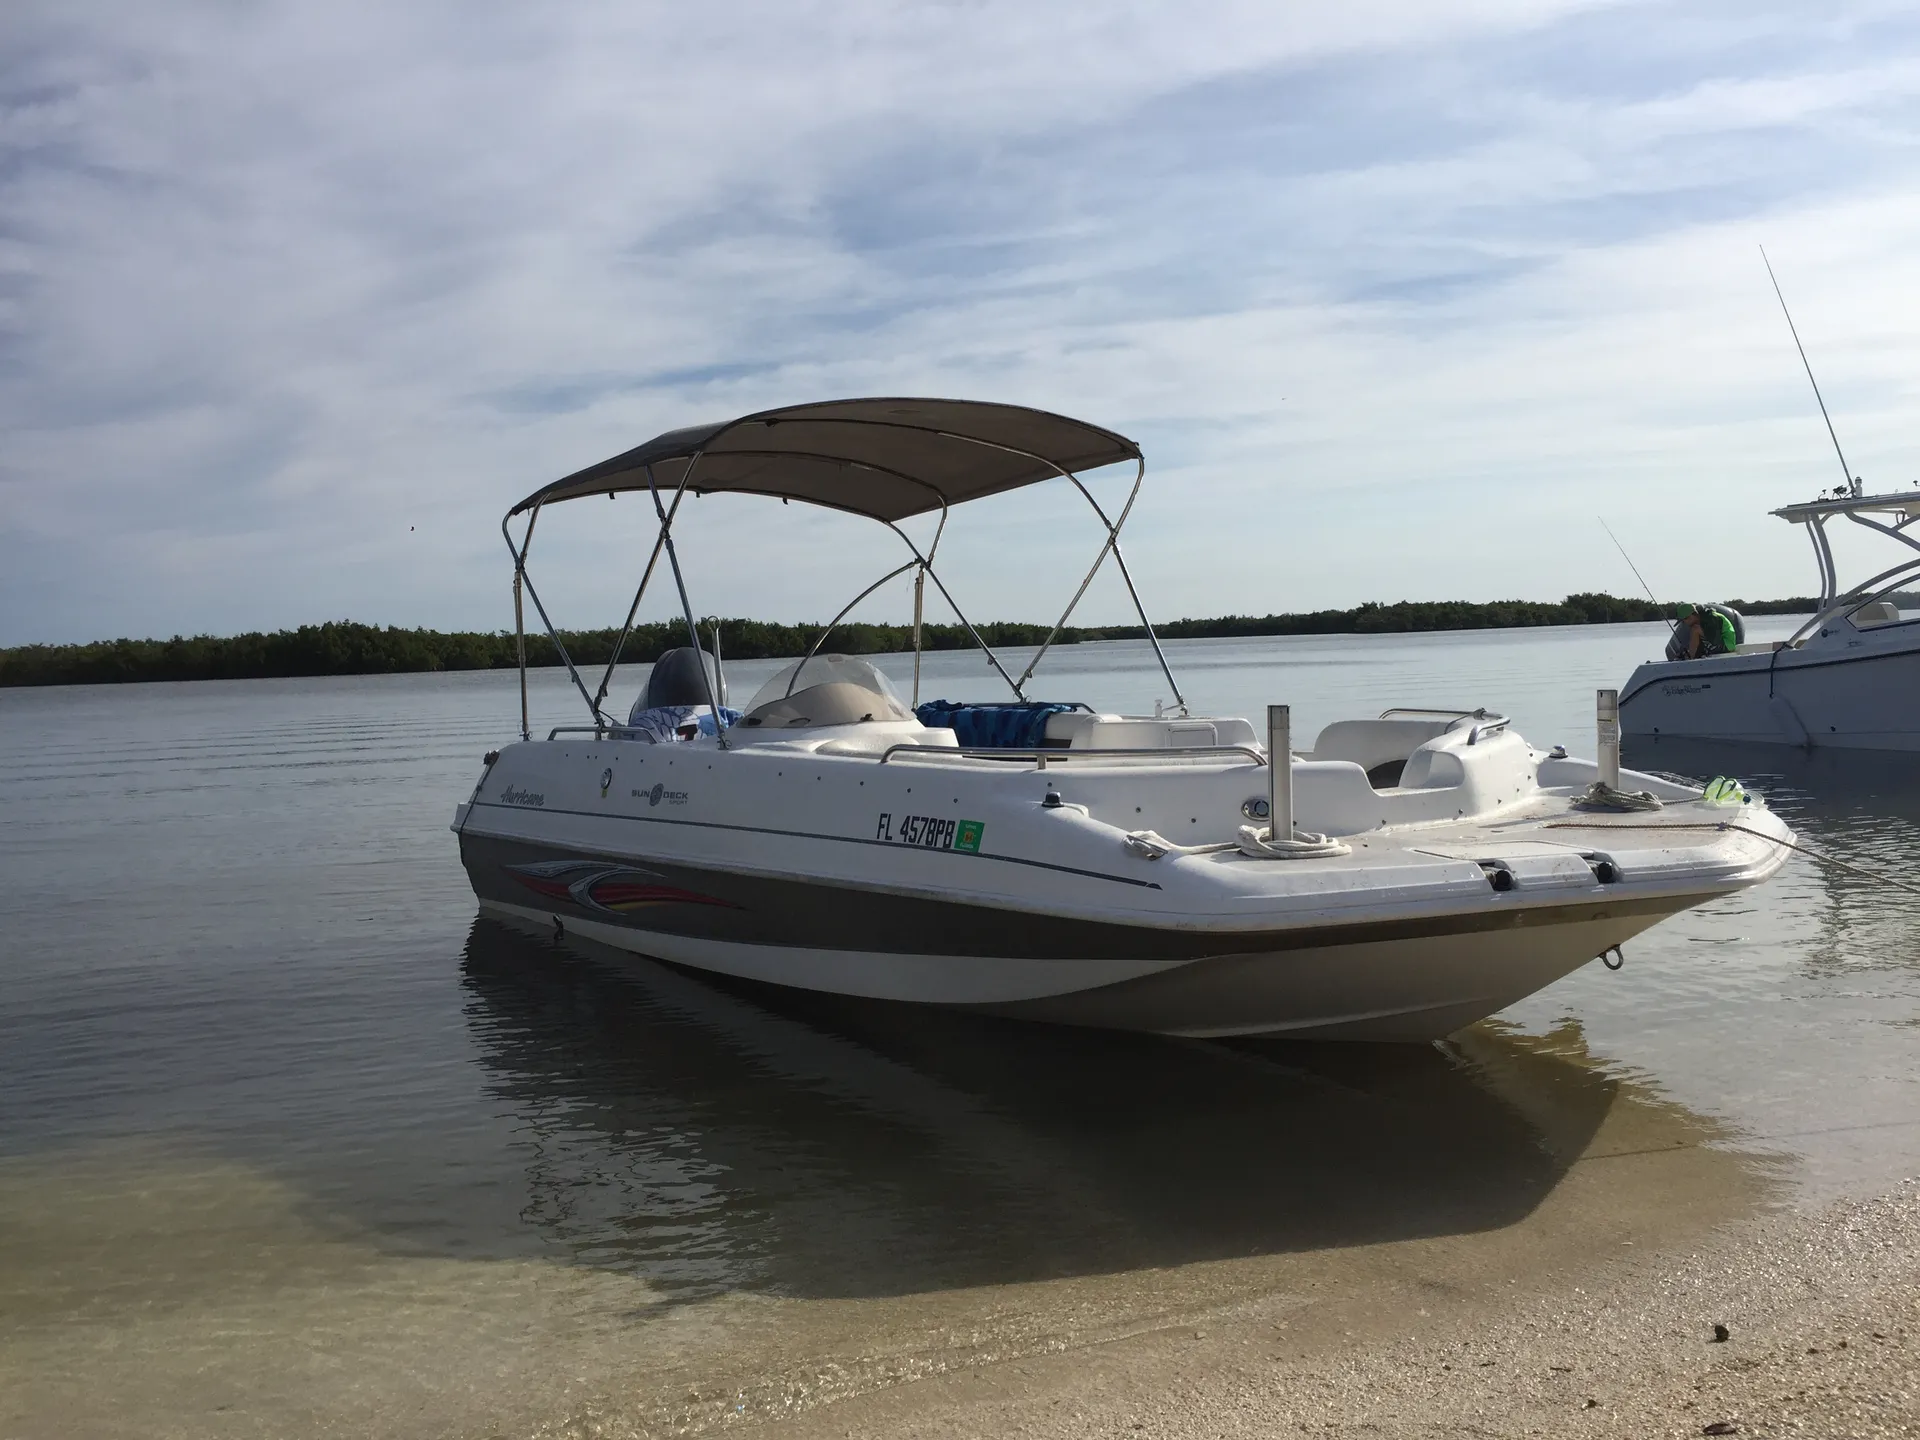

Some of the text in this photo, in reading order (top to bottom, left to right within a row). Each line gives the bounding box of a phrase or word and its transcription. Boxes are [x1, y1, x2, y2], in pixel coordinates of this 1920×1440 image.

[500, 784, 545, 806] Hurricane
[631, 789, 689, 799] SUN DECK
[876, 813, 956, 849] FL 4578PB
